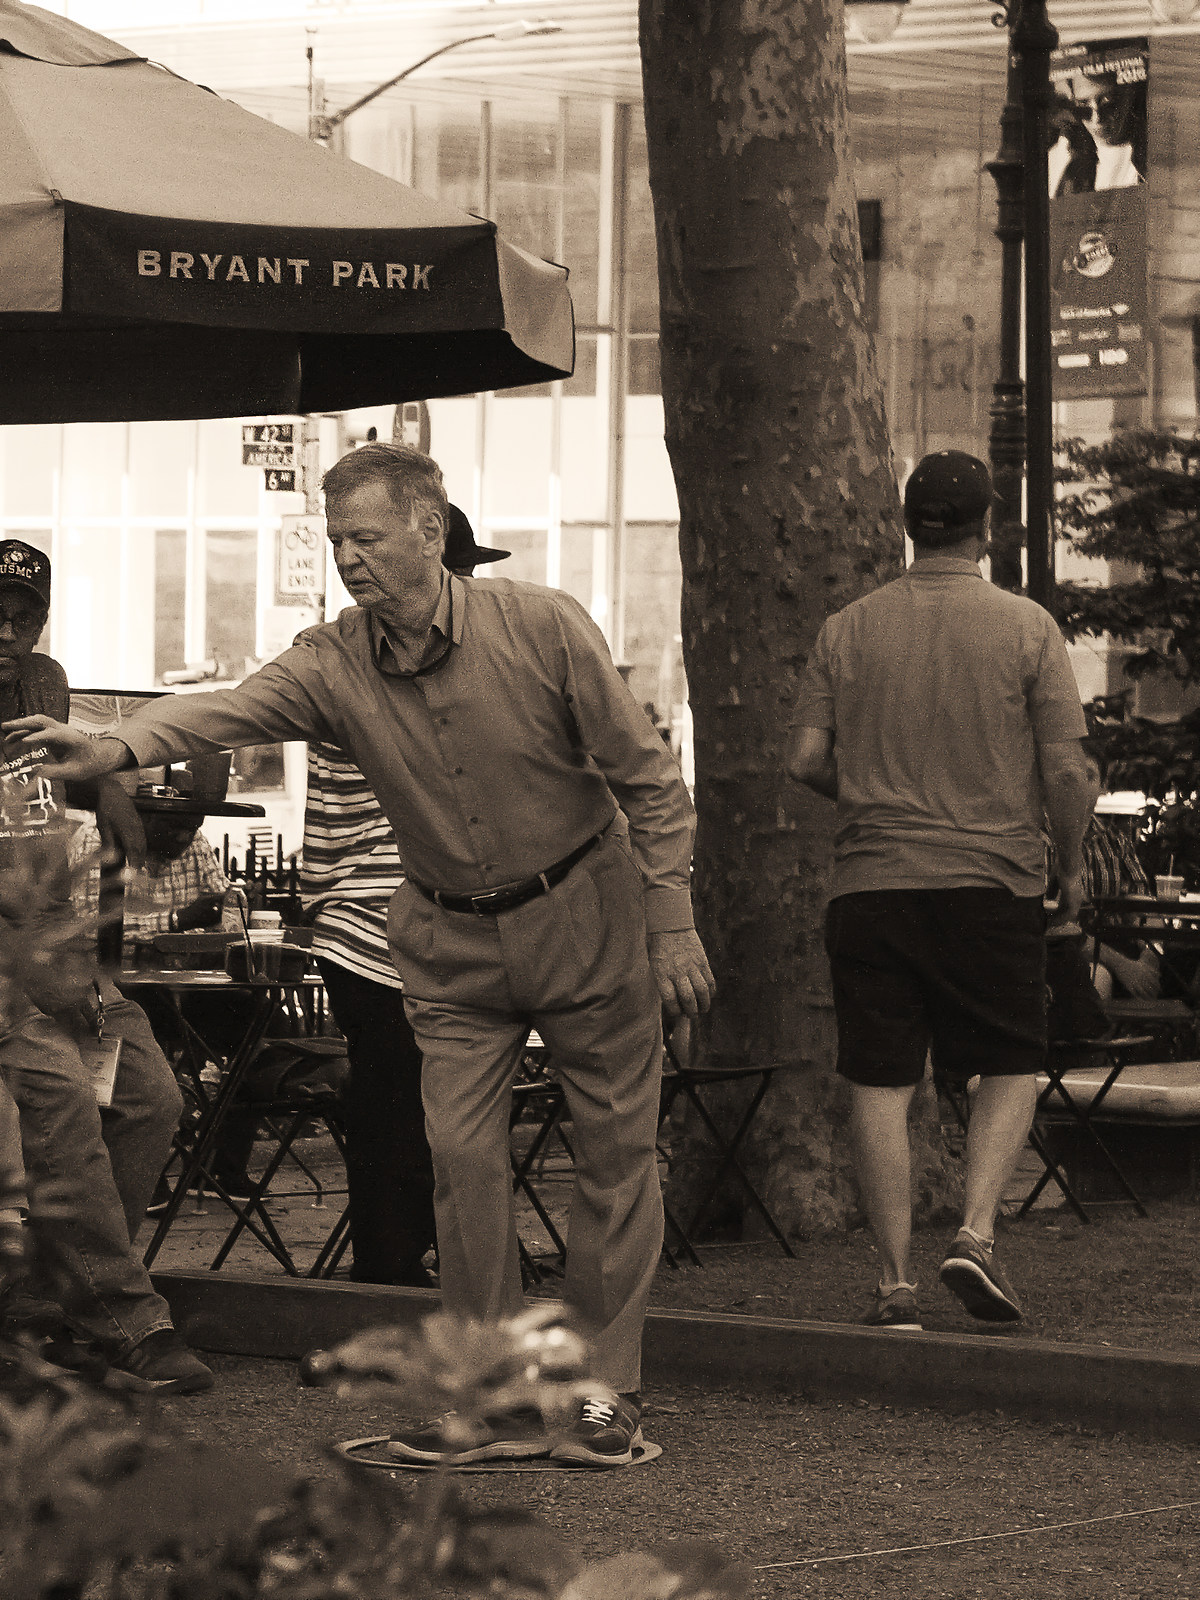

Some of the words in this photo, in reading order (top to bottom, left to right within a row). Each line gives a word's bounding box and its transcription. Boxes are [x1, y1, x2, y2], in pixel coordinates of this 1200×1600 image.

[137, 249, 310, 285] BRYANT
[332, 260, 435, 291] PARK
[260, 426, 280, 442] 42
[268, 471, 279, 490] 6
[0, 563, 33, 579] USMC
[288, 557, 315, 571] LANE
[288, 573, 316, 587] ENDS
